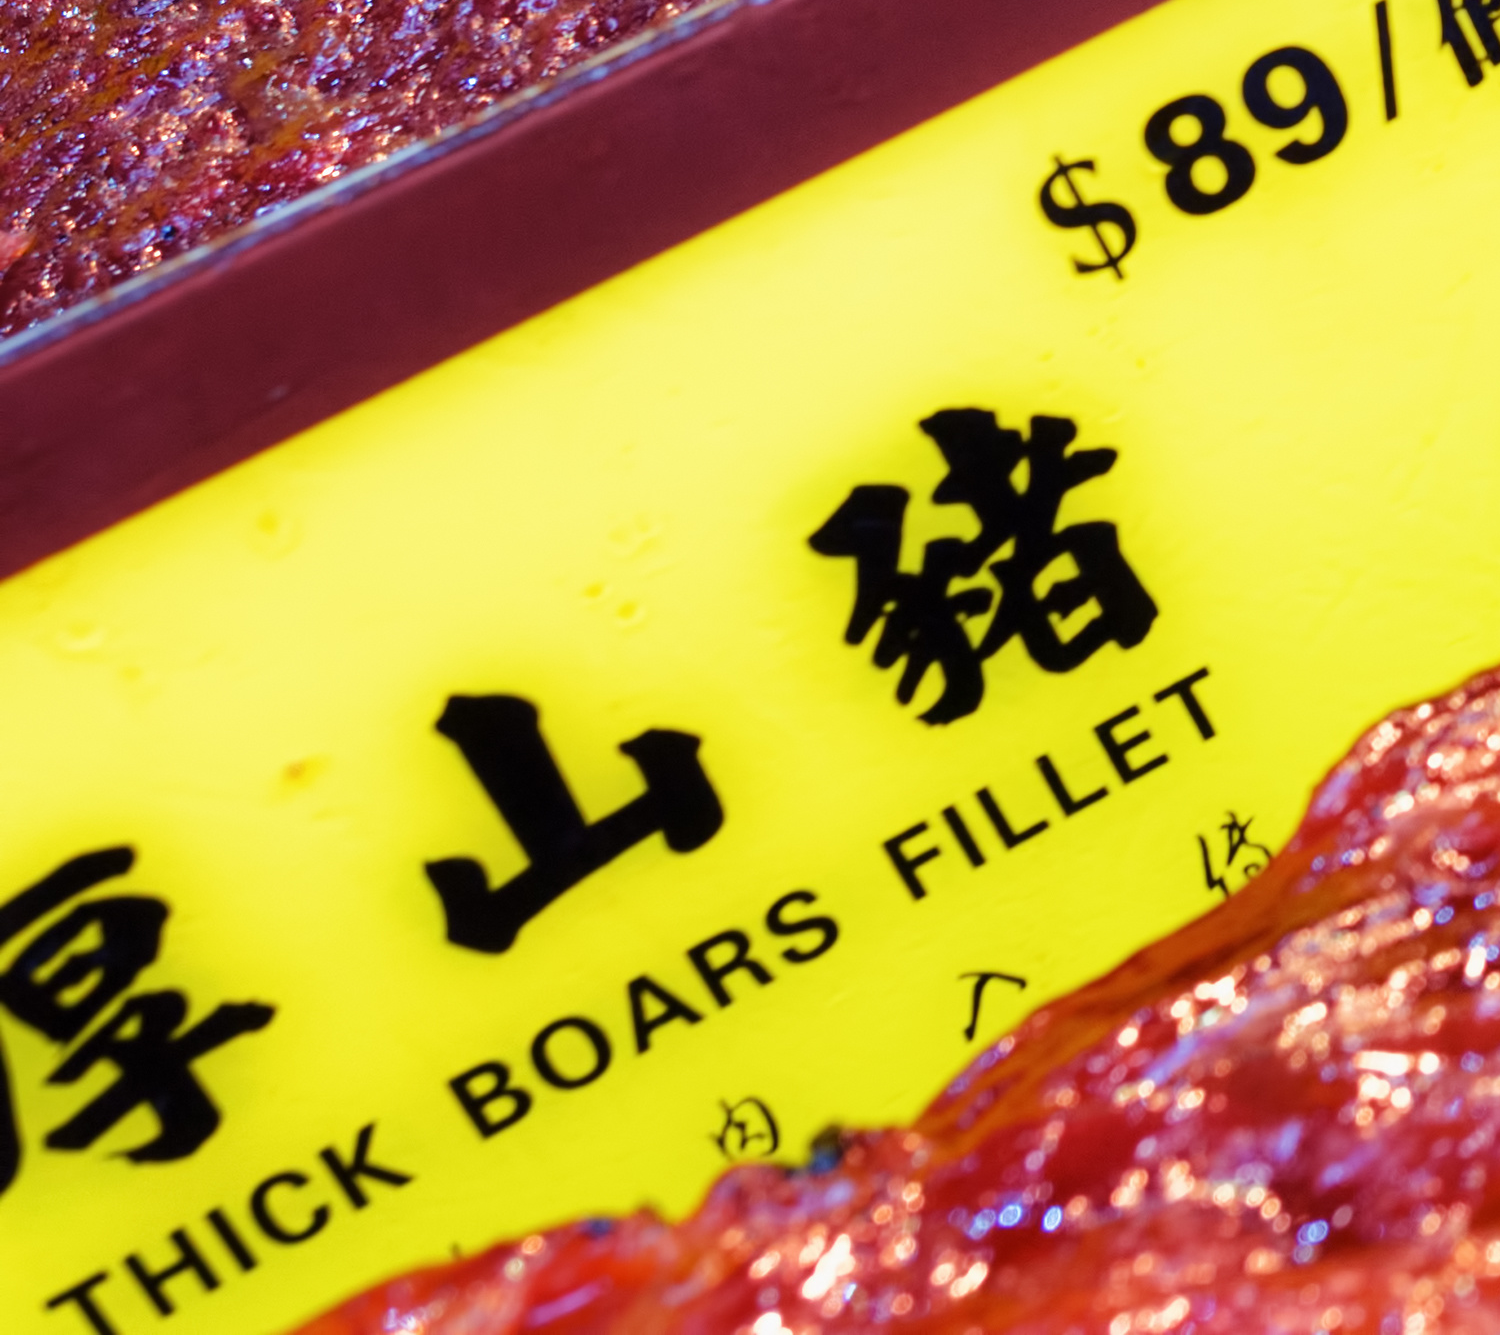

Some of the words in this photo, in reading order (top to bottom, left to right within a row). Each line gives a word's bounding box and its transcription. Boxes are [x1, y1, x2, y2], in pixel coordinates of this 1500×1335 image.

[0, 407, 1160, 1197] 厚山豬
[44, 1121, 416, 1335] THICK
[447, 887, 843, 1142] BOARS
[880, 665, 1218, 903] FILLET
